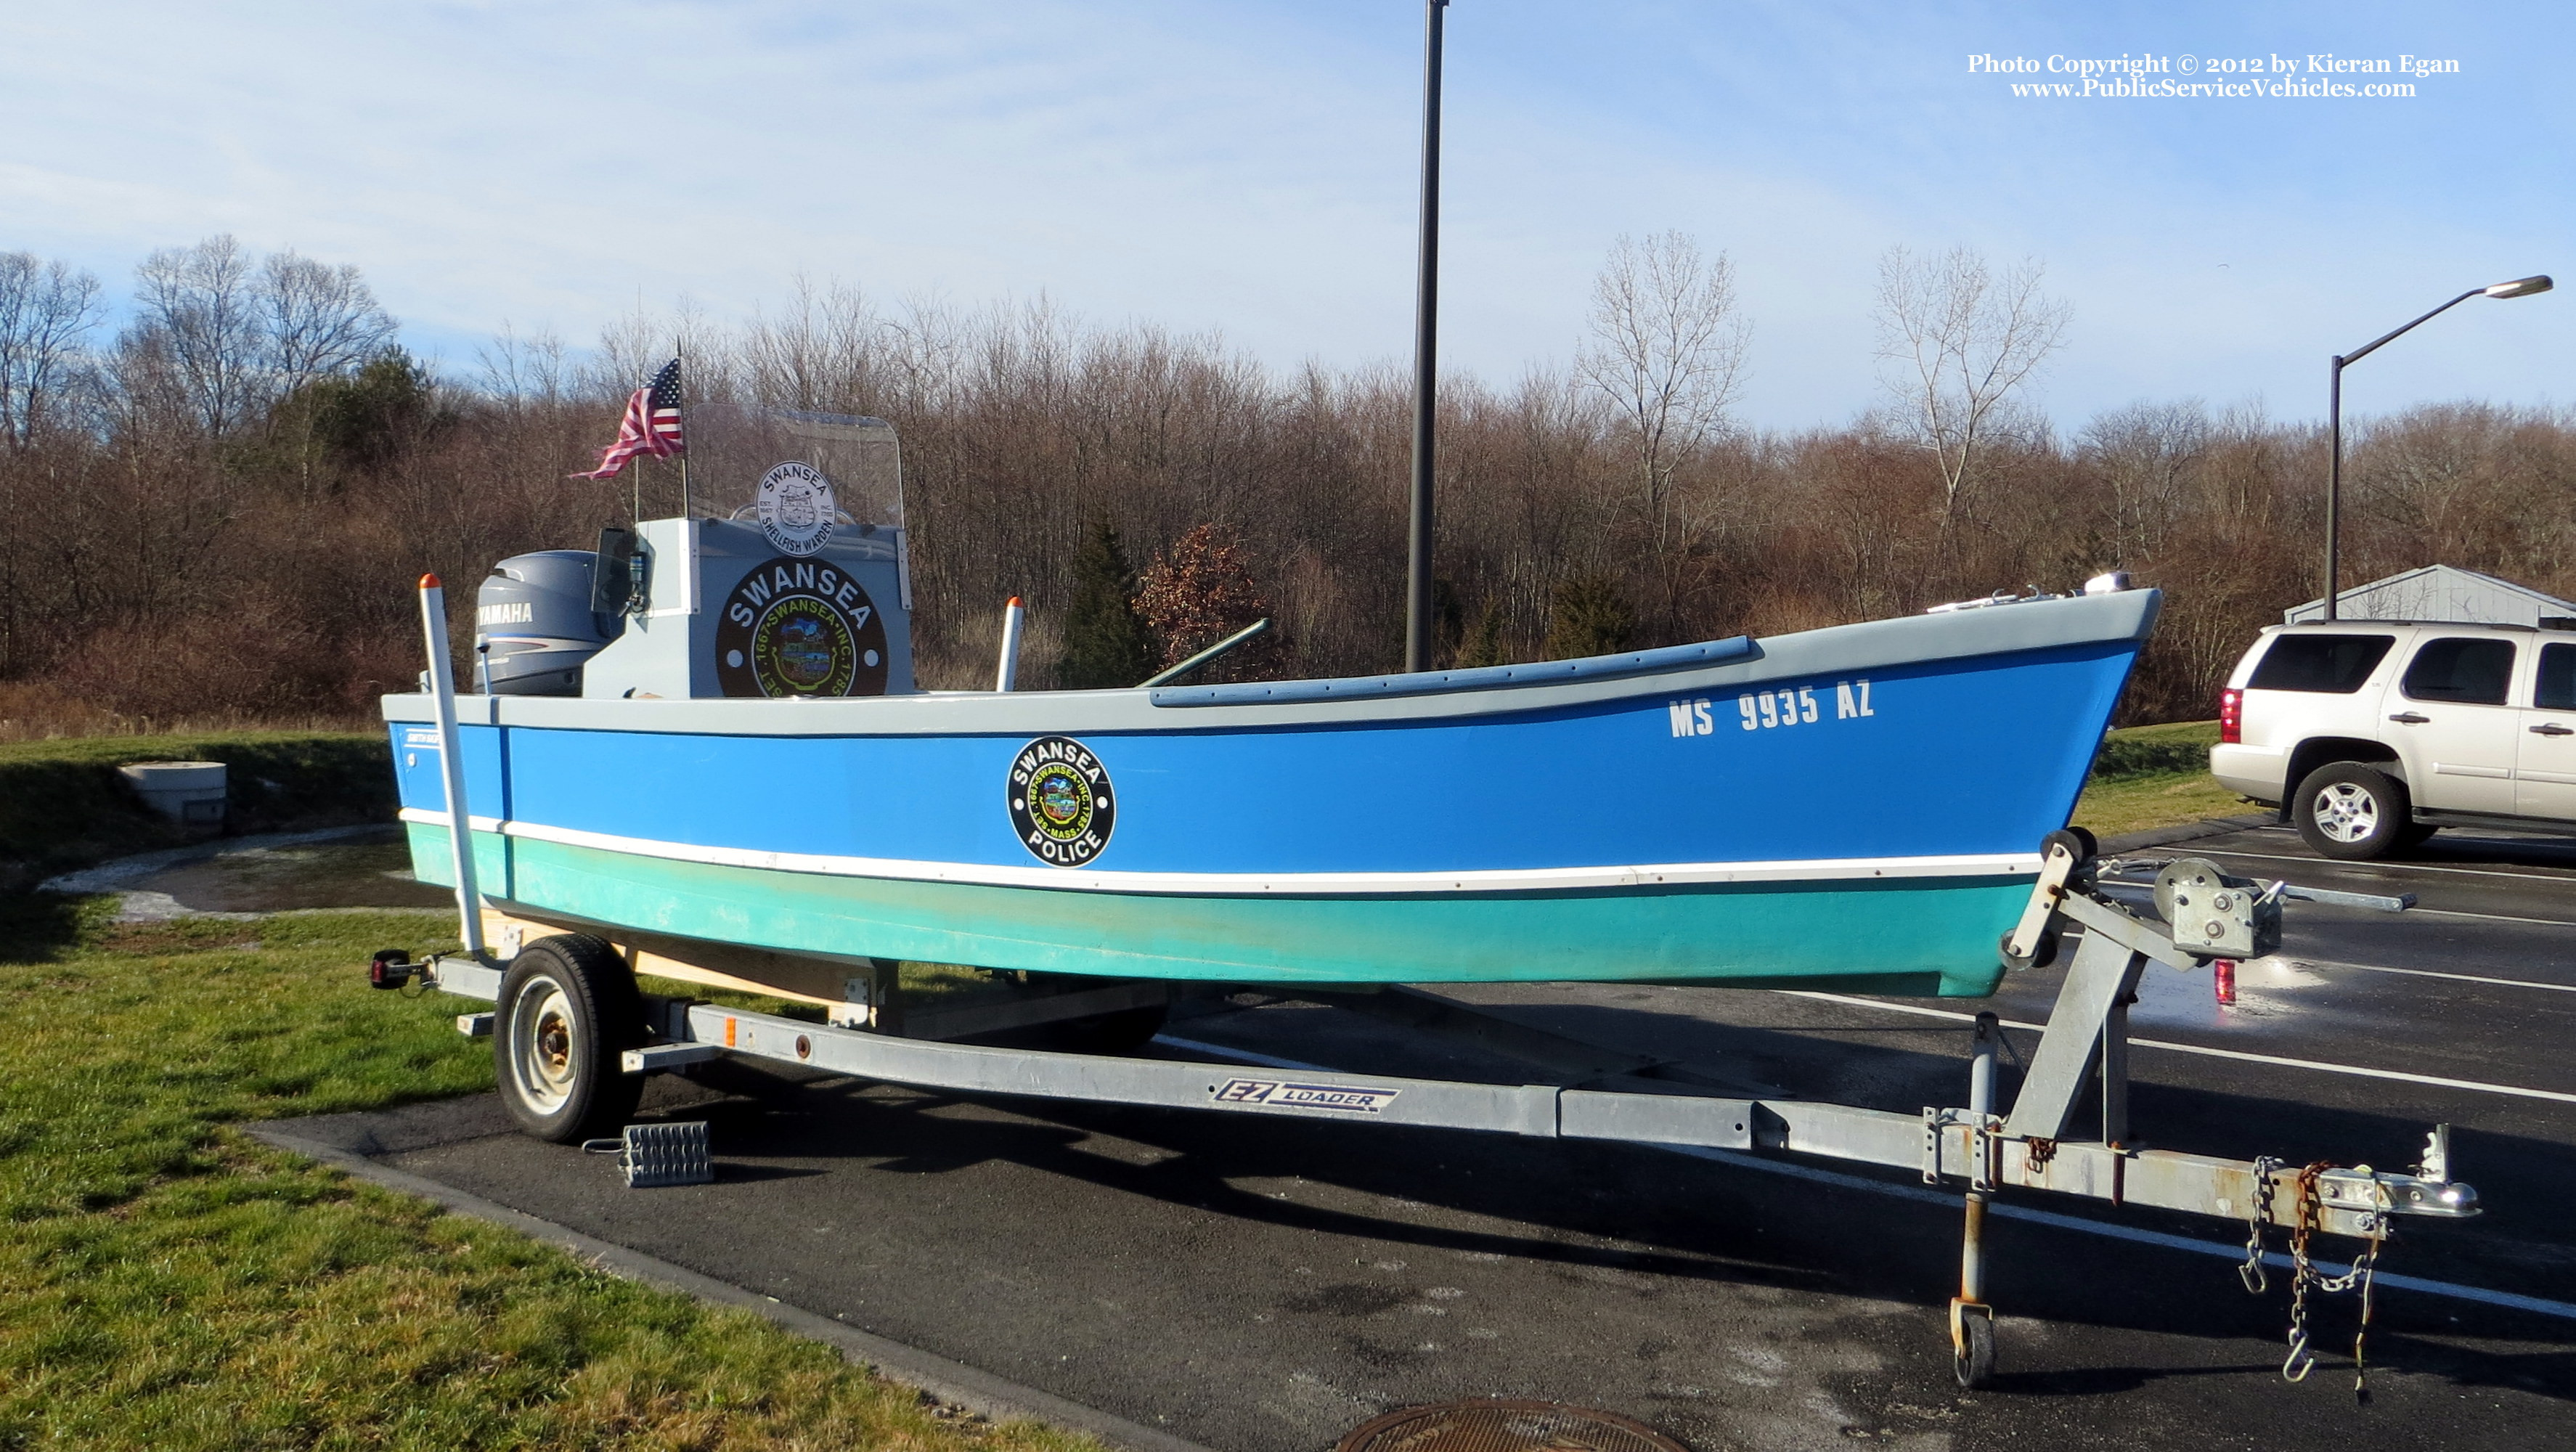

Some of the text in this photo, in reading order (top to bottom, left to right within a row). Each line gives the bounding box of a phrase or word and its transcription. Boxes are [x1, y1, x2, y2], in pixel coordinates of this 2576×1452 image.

[764, 465, 827, 497] SWANSEA
[762, 517, 833, 552] SHELLFISH WARDEN
[730, 563, 871, 630] SWANSEA
[478, 602, 534, 626] YAMAHA
[767, 600, 836, 626] SWANSEA
[1669, 679, 1874, 738] MS 9935 AZ
[1014, 741, 1101, 785] SWANSEA
[1035, 765, 1078, 783] SWANSEA
[1028, 829, 1102, 862] POLICE
[1051, 828, 1077, 839] MASS
[1220, 1081, 1376, 1106] EZ LOADER
